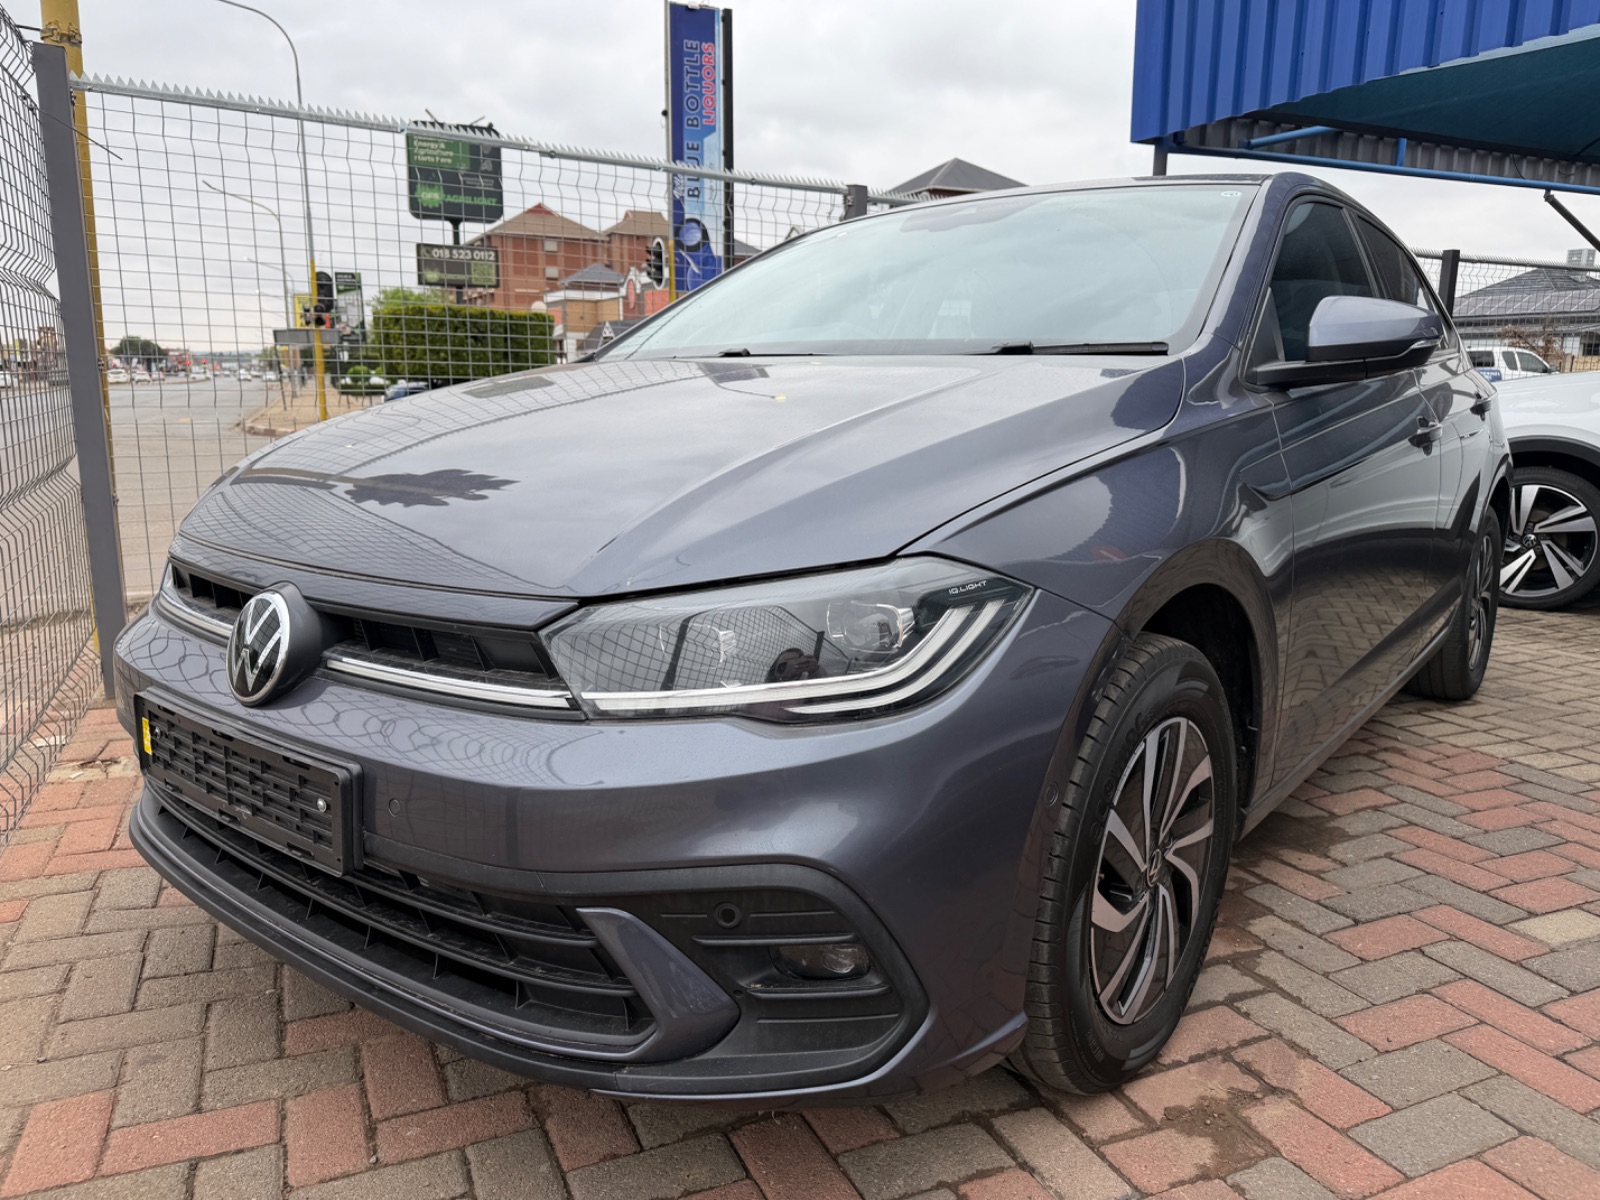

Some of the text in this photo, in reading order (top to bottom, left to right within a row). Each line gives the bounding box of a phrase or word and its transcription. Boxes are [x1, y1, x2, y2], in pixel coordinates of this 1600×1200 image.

[684, 39, 700, 198] BLUE BOTTLE
[701, 42, 715, 126] LIQUORS
[452, 249, 472, 260] 523
